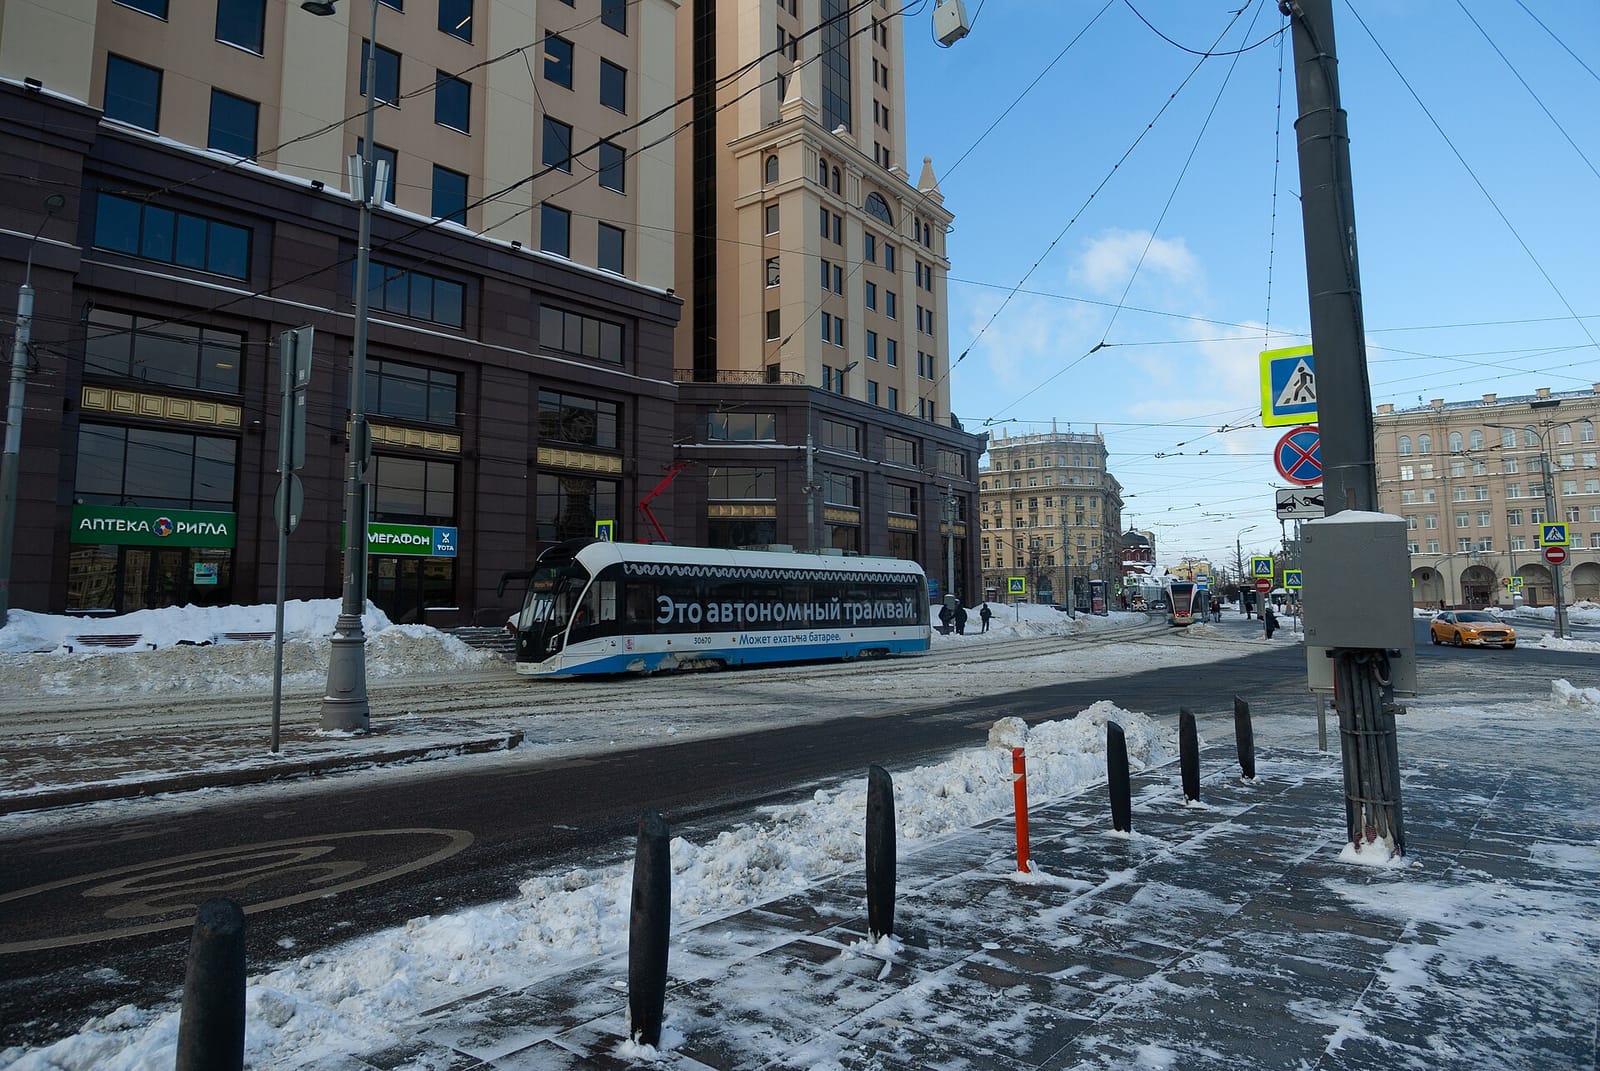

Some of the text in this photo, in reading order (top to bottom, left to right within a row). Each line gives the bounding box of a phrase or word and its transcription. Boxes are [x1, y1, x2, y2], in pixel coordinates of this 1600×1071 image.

[79, 518, 228, 536] АПТЕКА РИГЛА
[368, 532, 430, 545] МЕГАФОН
[656, 595, 918, 625] Это автономный трамвай.
[694, 636, 712, 645] 30670
[739, 631, 842, 645] Может ехать на батарее.
